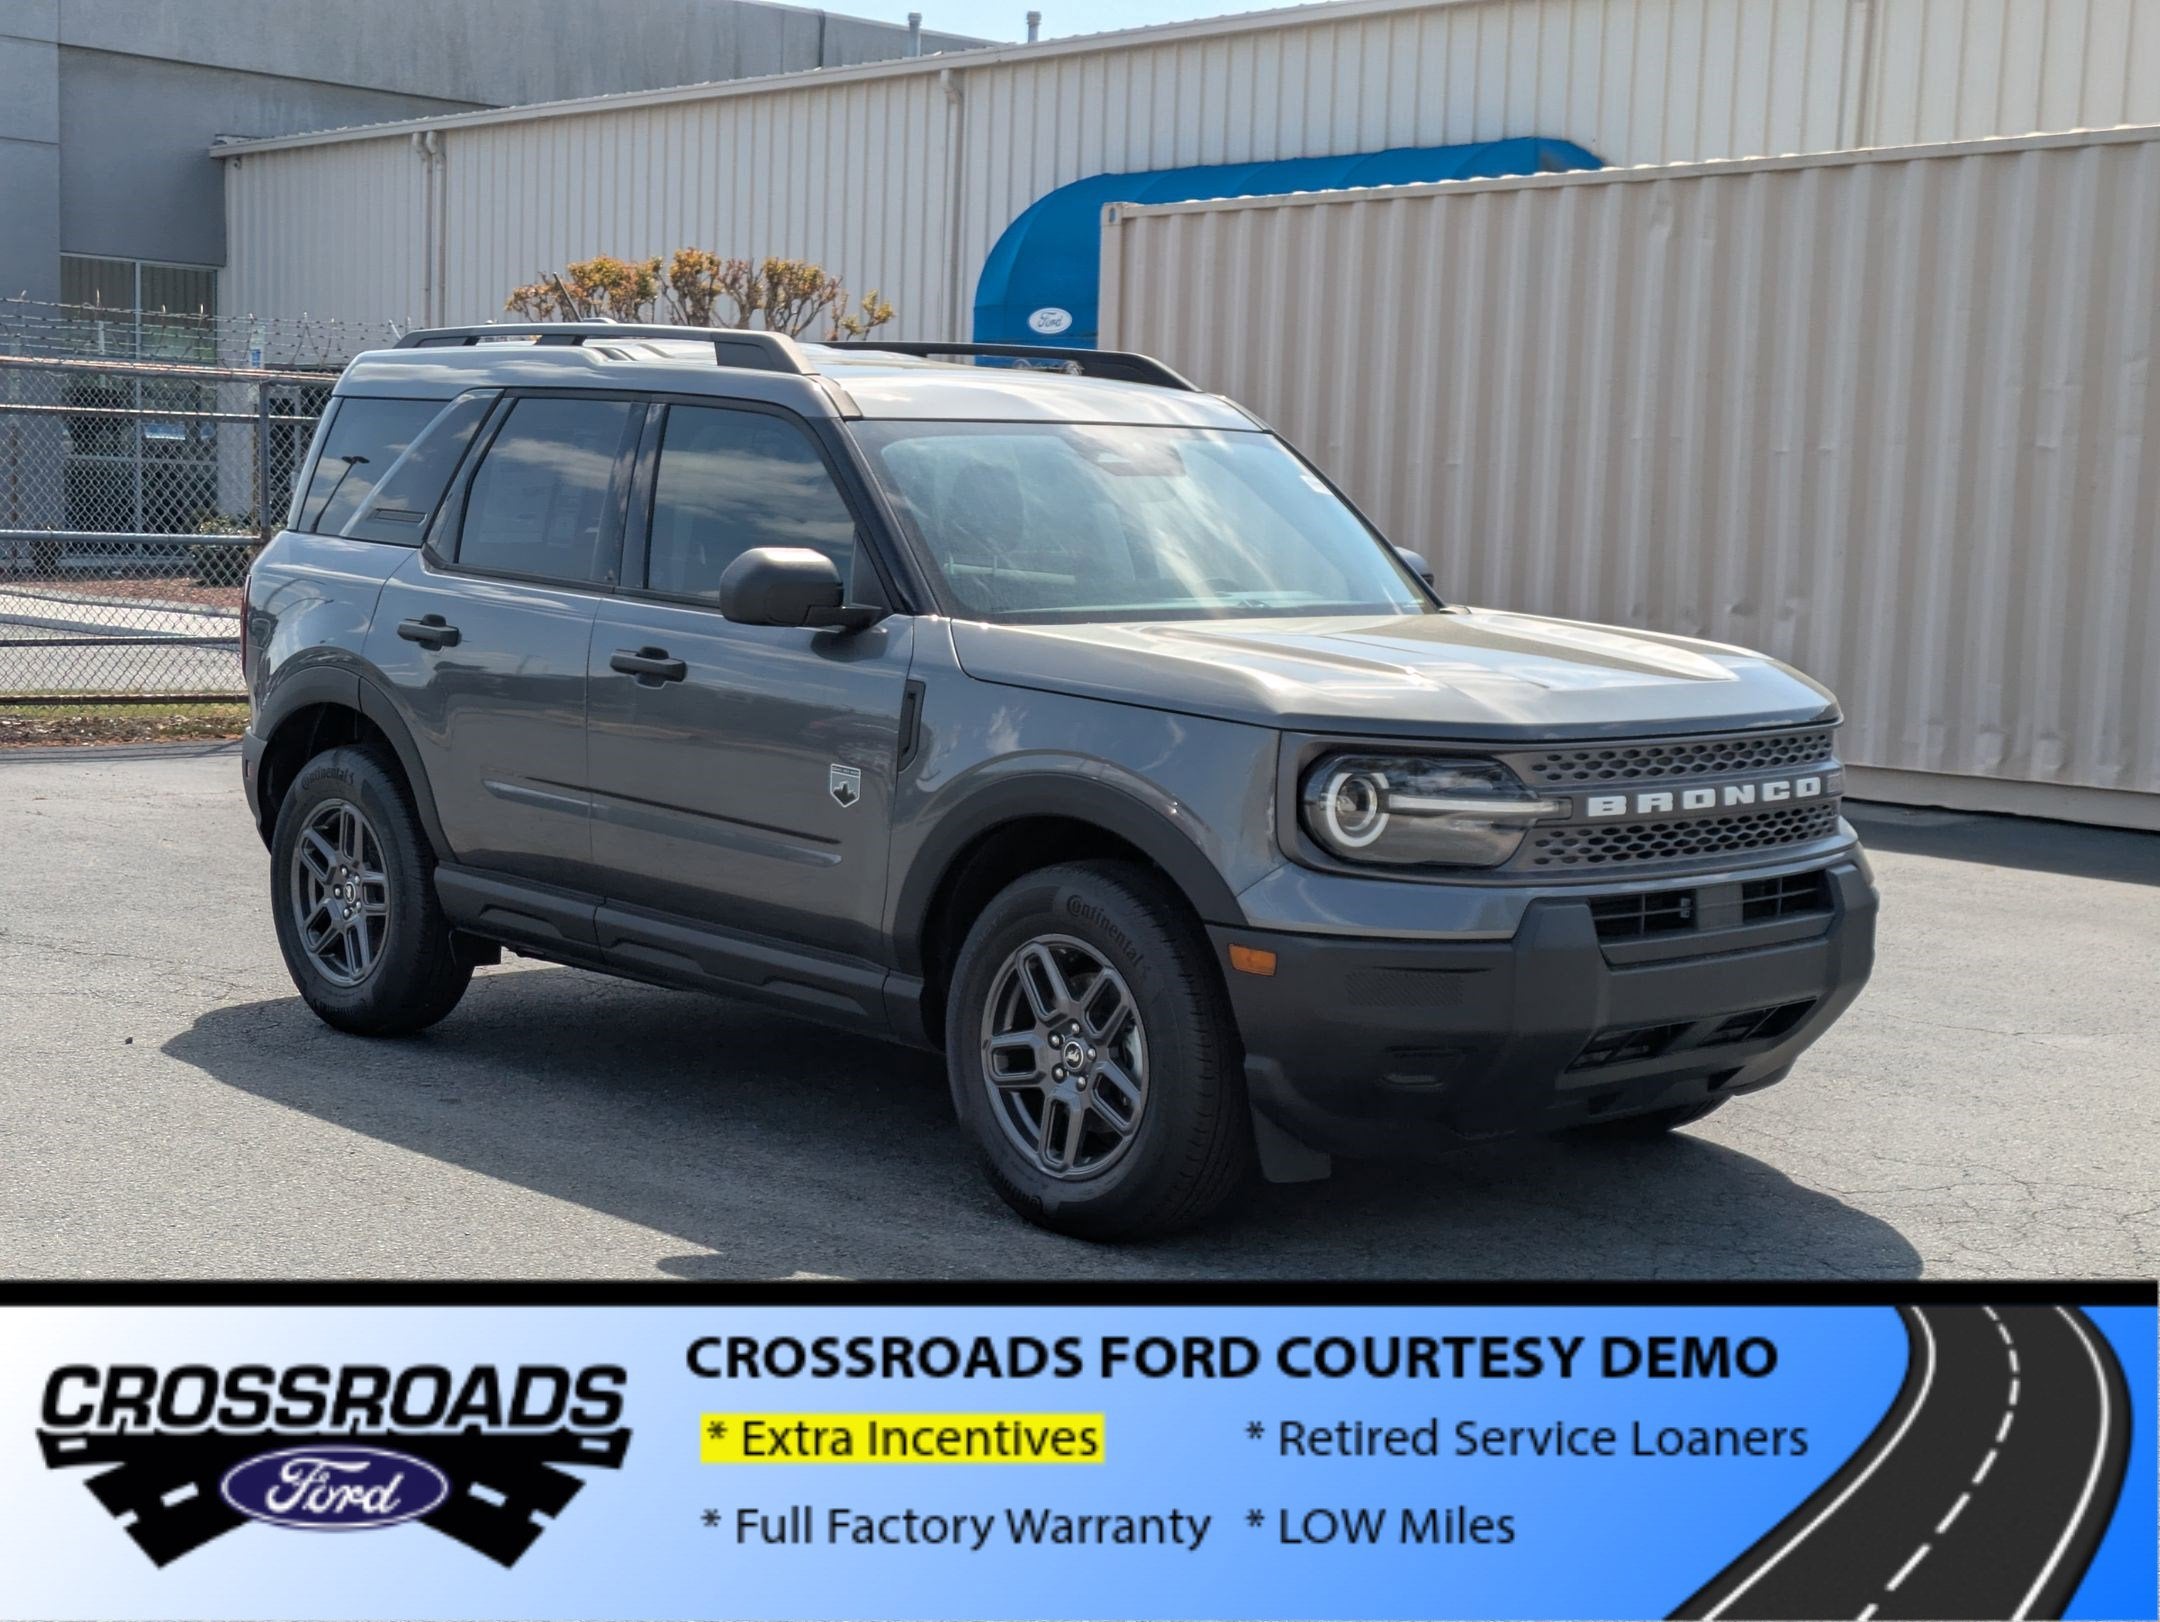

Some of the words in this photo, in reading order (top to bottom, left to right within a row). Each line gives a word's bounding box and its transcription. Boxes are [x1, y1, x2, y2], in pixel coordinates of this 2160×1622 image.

[1037, 311, 1064, 329] Ford
[1587, 776, 1821, 817] BRONCO
[1066, 894, 1144, 968] Continental
